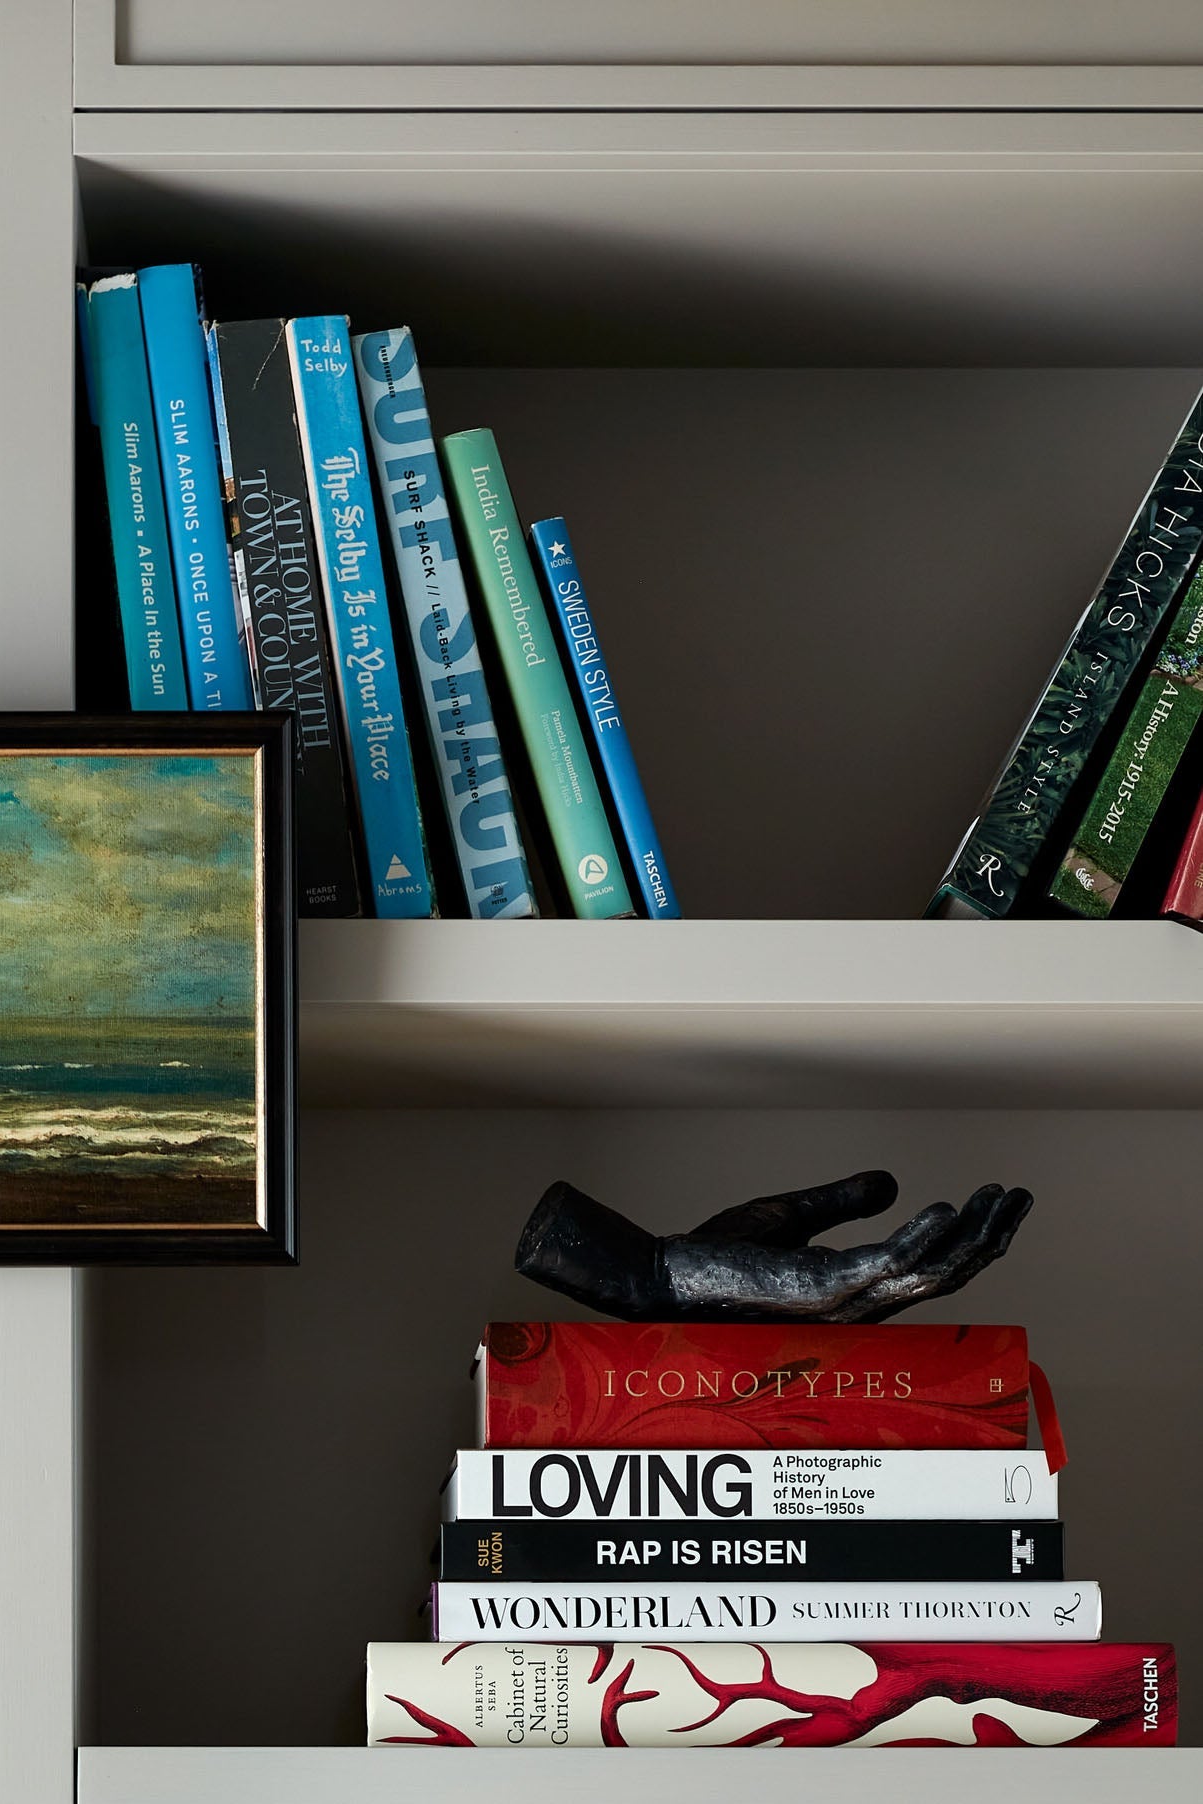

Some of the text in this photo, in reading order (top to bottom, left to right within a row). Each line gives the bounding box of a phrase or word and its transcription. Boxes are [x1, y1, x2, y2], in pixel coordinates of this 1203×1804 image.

[301, 339, 341, 354] Todd
[305, 358, 347, 378] Selby
[404, 470, 423, 513] SURF
[123, 423, 165, 696] Slim Aarons A Place In the Sun
[170, 400, 221, 709] SLIM AARONS ONCE UPON A TI
[414, 520, 436, 579] SHACK
[471, 464, 546, 667] India Remembered
[550, 557, 573, 568] ICONS
[1107, 507, 1188, 631] HICKS
[240, 469, 295, 711] TOWN & COUN
[272, 490, 331, 749] AT HOME WITH
[321, 447, 394, 781] The Selby Is in Your Place
[1185, 606, 1203, 645] ston
[431, 602, 452, 670] Laid-Back
[559, 580, 620, 732] SWEDEN STYLE
[446, 674, 461, 717] Living
[1162, 680, 1179, 697] A
[455, 720, 466, 737] by
[1018, 651, 1108, 813] ISLAND STYLE
[462, 741, 471, 763] the
[551, 710, 583, 804] Pamela Mountbatten
[466, 767, 480, 804] Water
[306, 884, 337, 896] HEARST
[309, 894, 337, 904] BOOKS
[378, 883, 422, 896] Abrams
[584, 886, 614, 901] PAVILION
[643, 851, 669, 909] TASCHEN
[604, 1370, 912, 1398] ICONOTYPES
[773, 1455, 882, 1471] A Photographic
[773, 1471, 825, 1486] History
[492, 1453, 753, 1517] LOVING
[773, 1487, 875, 1499] of Men in Love
[478, 1539, 489, 1567] SUE
[491, 1531, 503, 1574] KWON
[597, 1540, 807, 1565] RAP IS RISEN
[469, 1595, 777, 1629] WONDERLAND
[792, 1601, 1032, 1619] SUMMER THORNTON
[475, 1665, 484, 1728] ALBERTUS
[488, 1680, 496, 1711] SEBA
[504, 1646, 525, 1744] Cabinet of
[527, 1660, 547, 1732] Natural
[550, 1647, 569, 1745] Curiosities
[1143, 1657, 1158, 1732] TASCHEN
